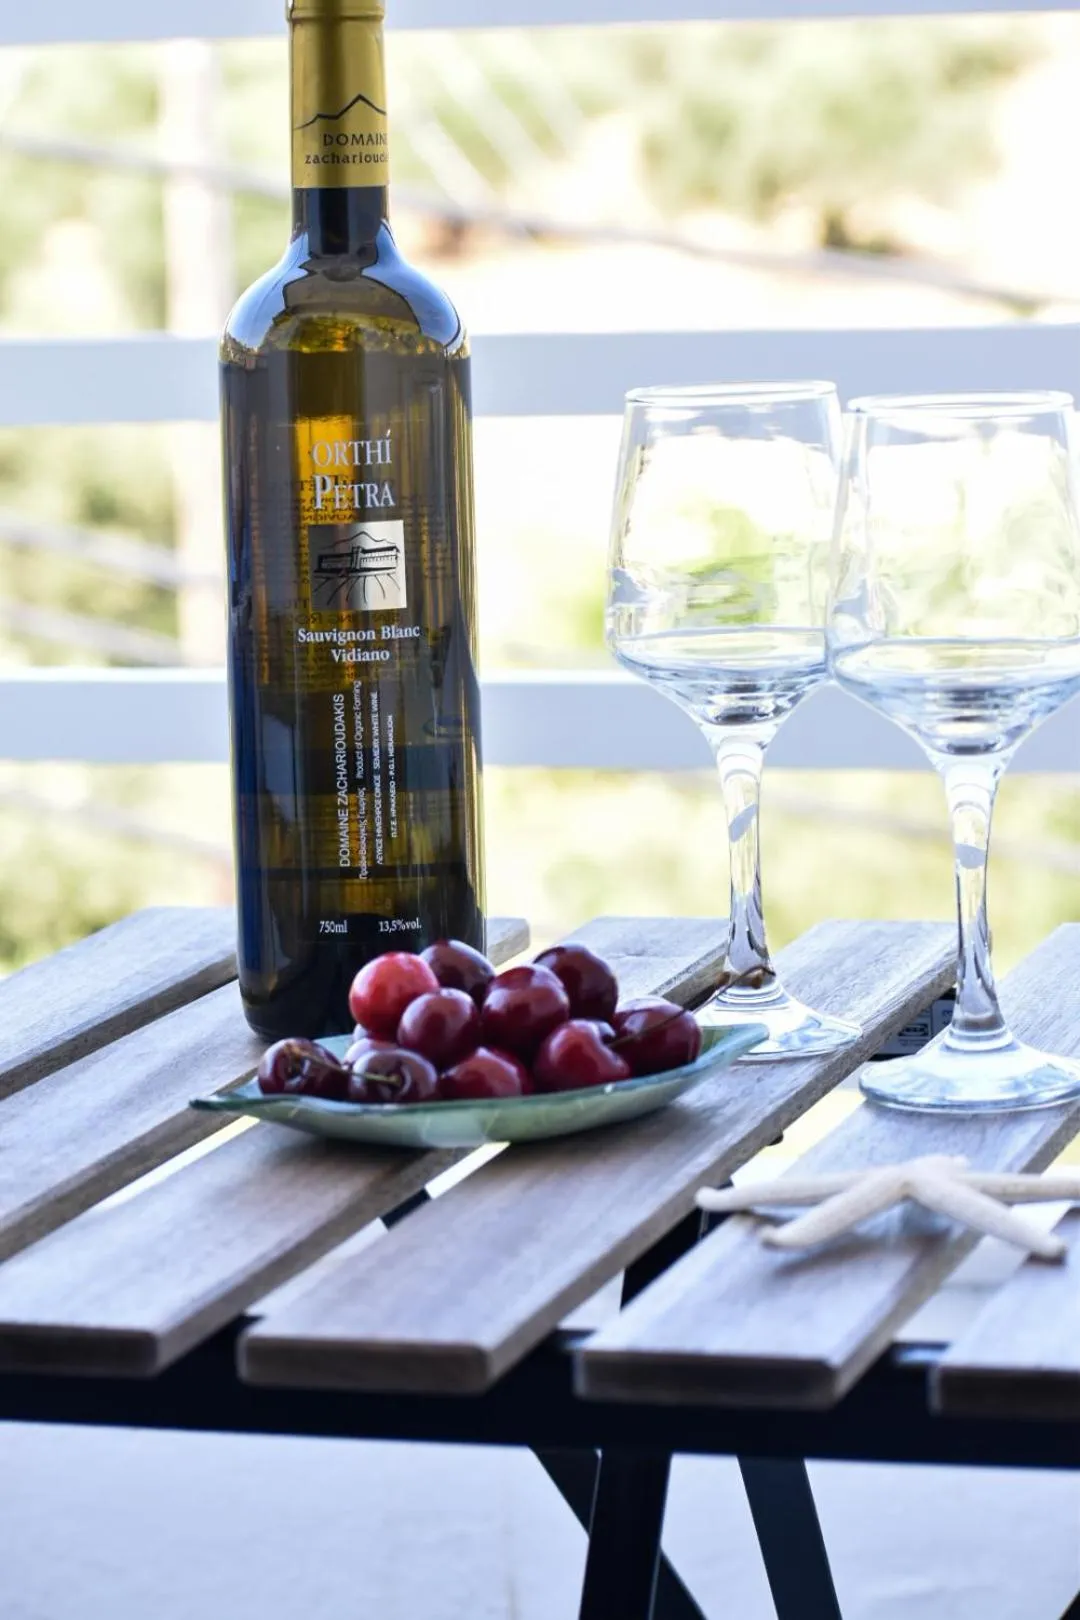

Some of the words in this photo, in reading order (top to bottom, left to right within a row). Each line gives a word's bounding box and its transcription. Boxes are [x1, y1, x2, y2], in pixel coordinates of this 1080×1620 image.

[323, 133, 388, 146] DOMAIN
[312, 429, 392, 467] ORTHÍ
[313, 475, 396, 509] PETRA
[298, 628, 376, 646] Sauvignon
[381, 625, 420, 640] Blanc
[331, 648, 390, 663] Vidiano
[355, 712, 364, 741] Organic
[334, 694, 348, 806] ZACHARIOUDAKIS
[356, 751, 364, 778] Product
[339, 808, 350, 867] DOMAINE
[320, 920, 348, 933] 750ml
[378, 917, 422, 933] 13,5%vol.
